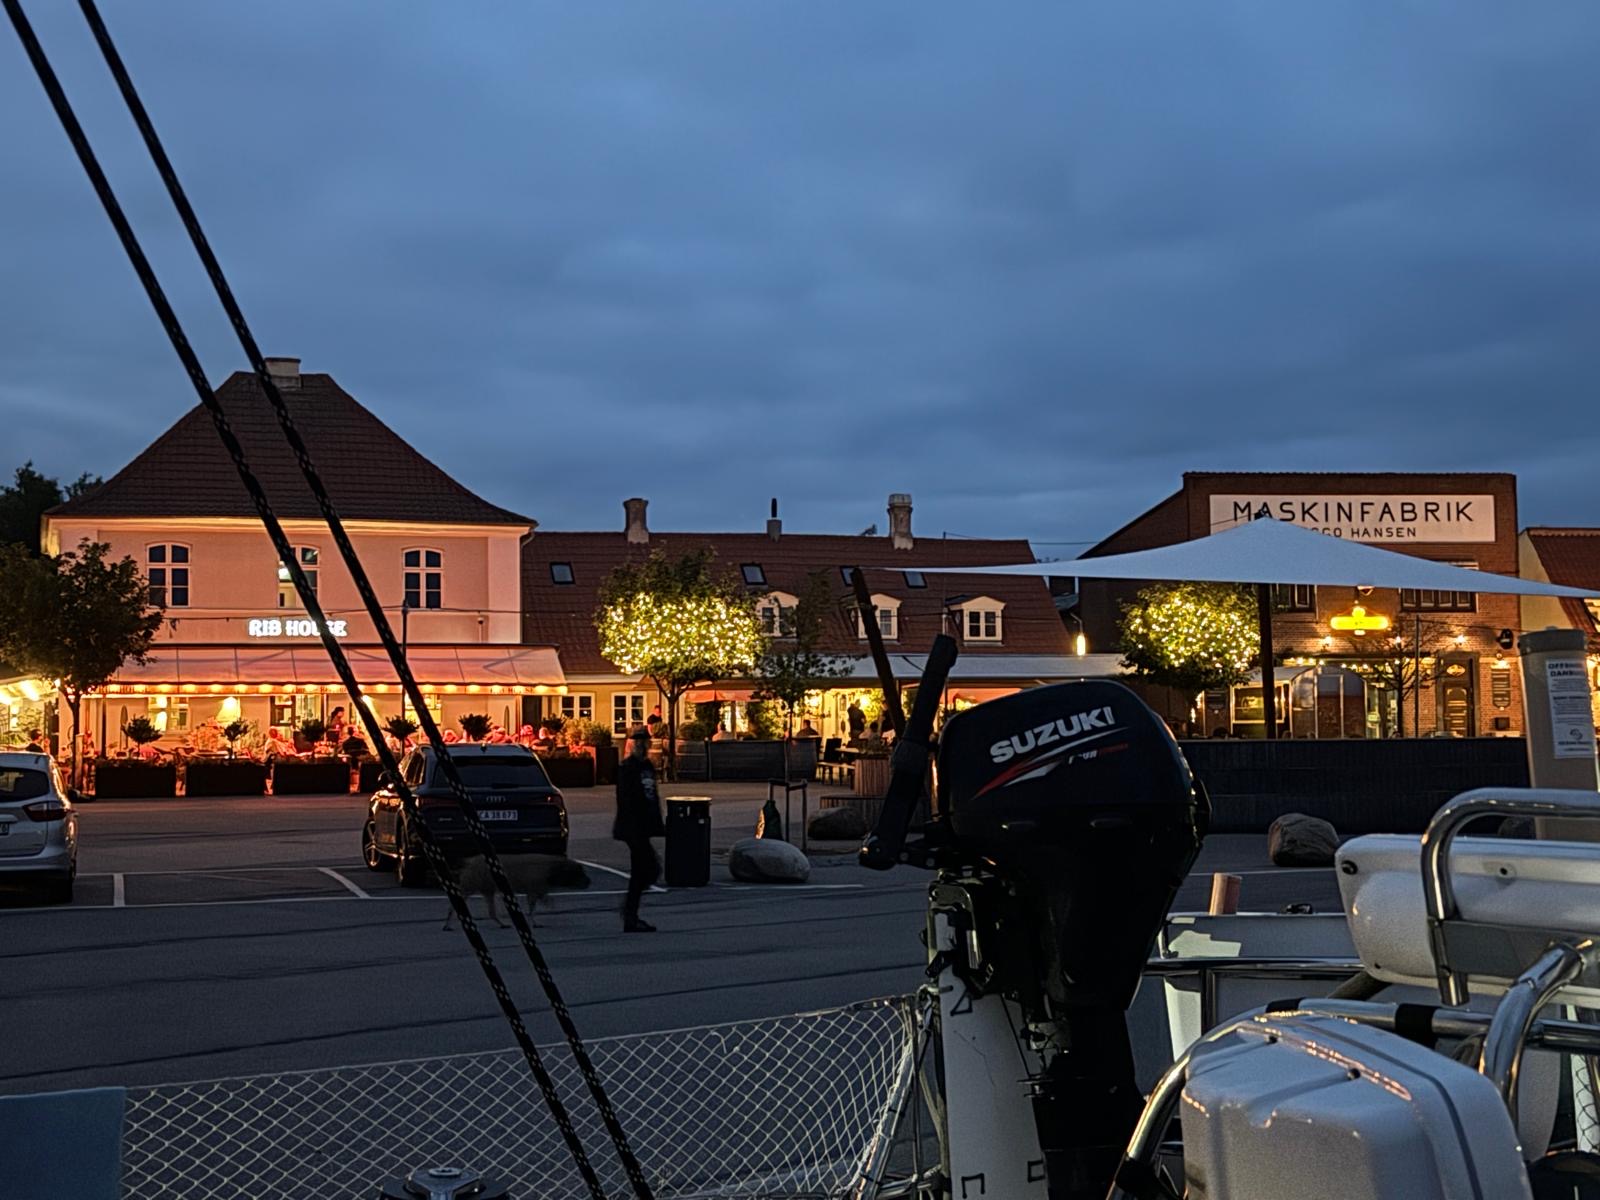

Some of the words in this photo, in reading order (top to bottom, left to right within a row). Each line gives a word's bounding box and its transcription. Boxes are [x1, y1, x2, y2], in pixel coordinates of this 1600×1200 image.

[1233, 501, 1473, 522] MASKINFABRIK
[1351, 527, 1416, 538] HANSEN
[249, 619, 282, 637] RIB
[990, 706, 1116, 764] SUZUKI
